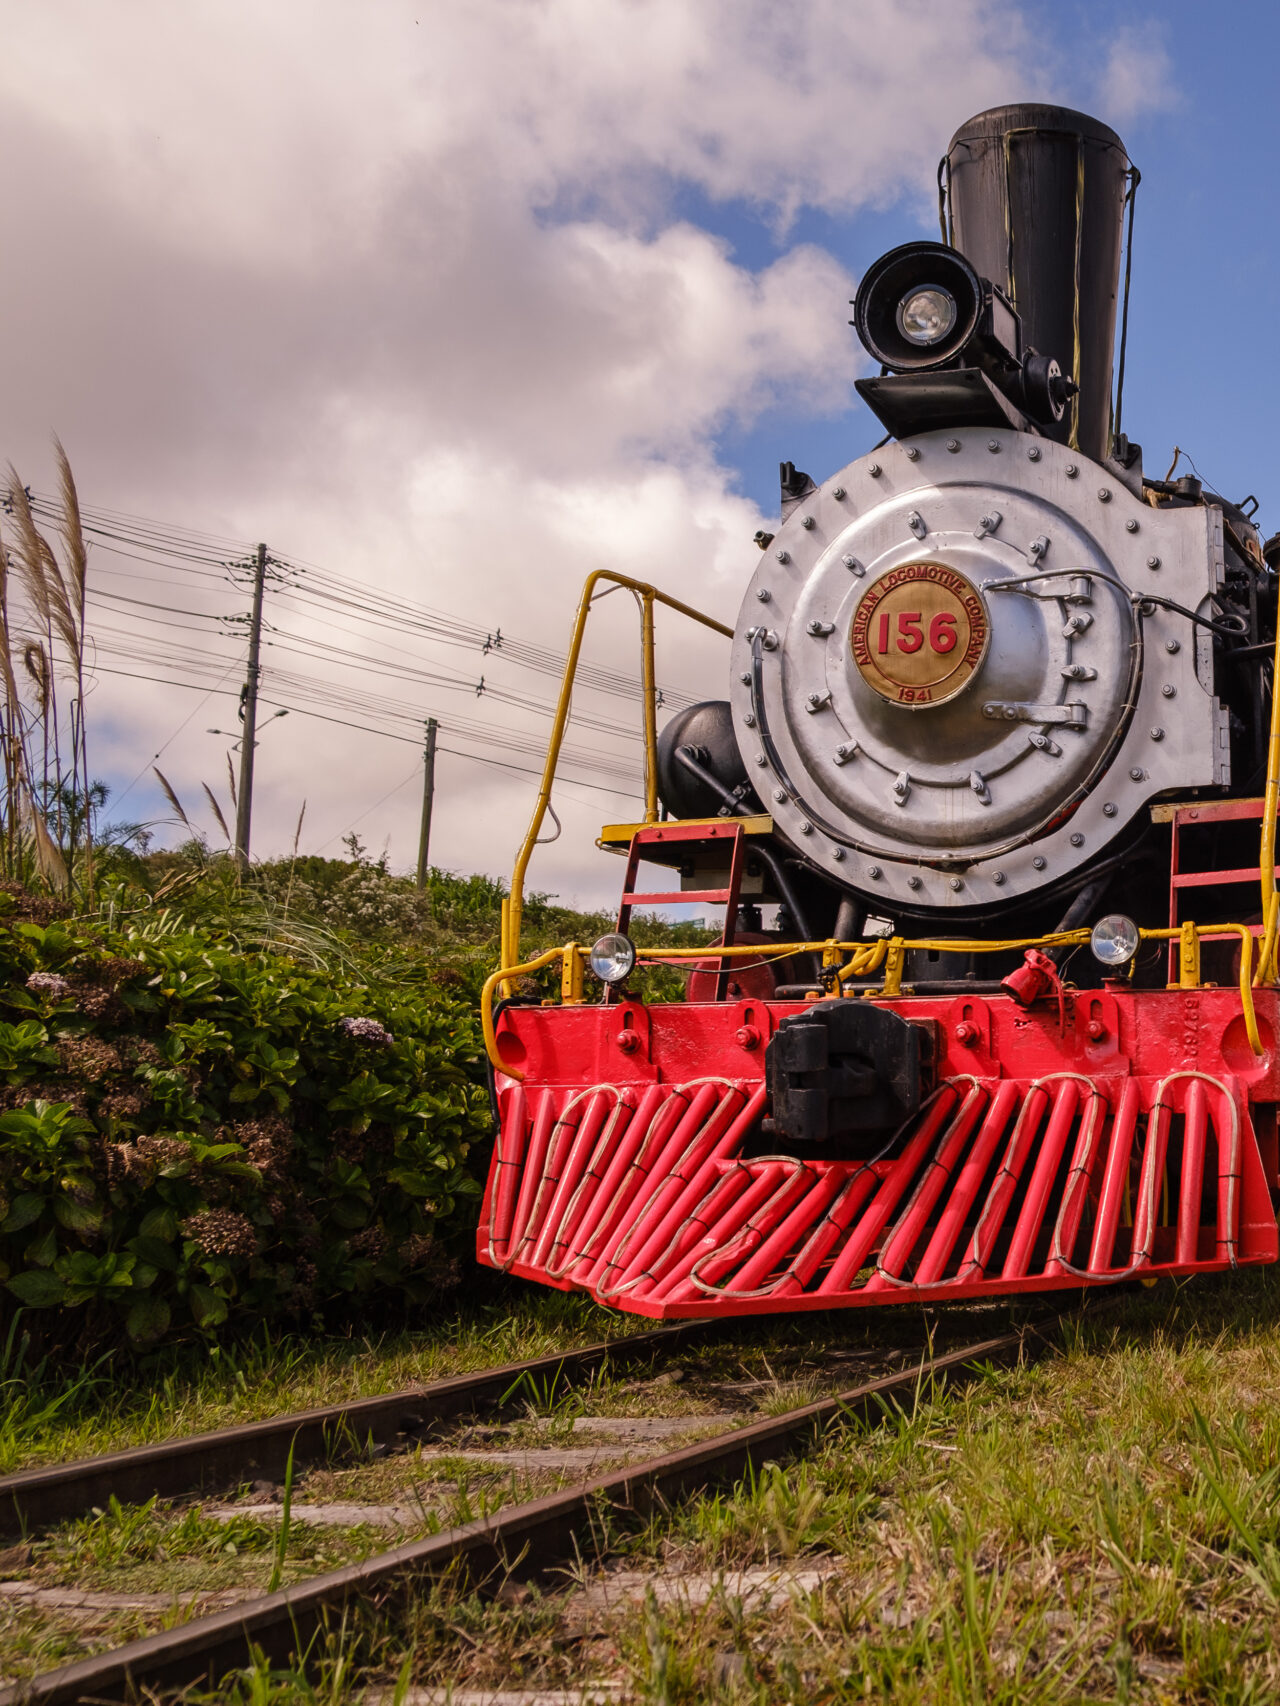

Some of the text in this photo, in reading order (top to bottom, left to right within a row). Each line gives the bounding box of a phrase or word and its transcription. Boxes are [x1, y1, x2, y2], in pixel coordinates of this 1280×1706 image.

[853, 566, 984, 669] AMERICAN LOCOMOTIVE COMPANY
[878, 612, 957, 654] 156
[899, 688, 932, 701] 1941
